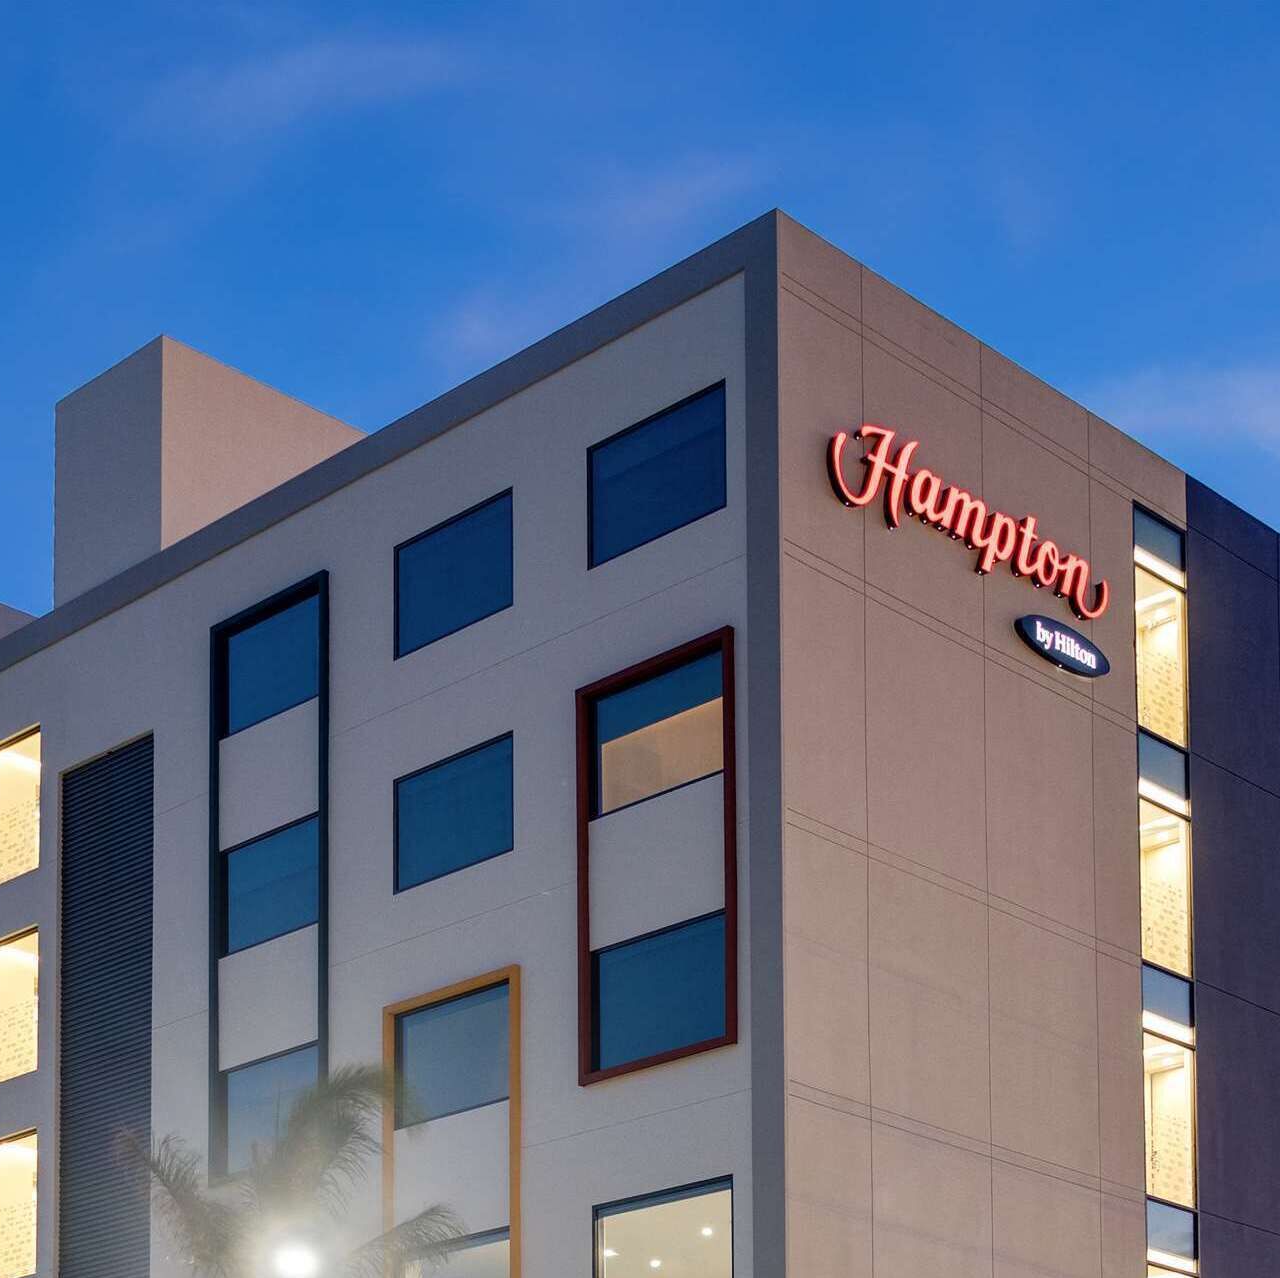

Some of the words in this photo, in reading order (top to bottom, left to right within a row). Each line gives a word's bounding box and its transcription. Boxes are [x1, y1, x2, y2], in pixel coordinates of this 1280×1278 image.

[827, 424, 1110, 620] Hampton
[1035, 621, 1054, 650] by
[1054, 631, 1097, 669] Hilton
